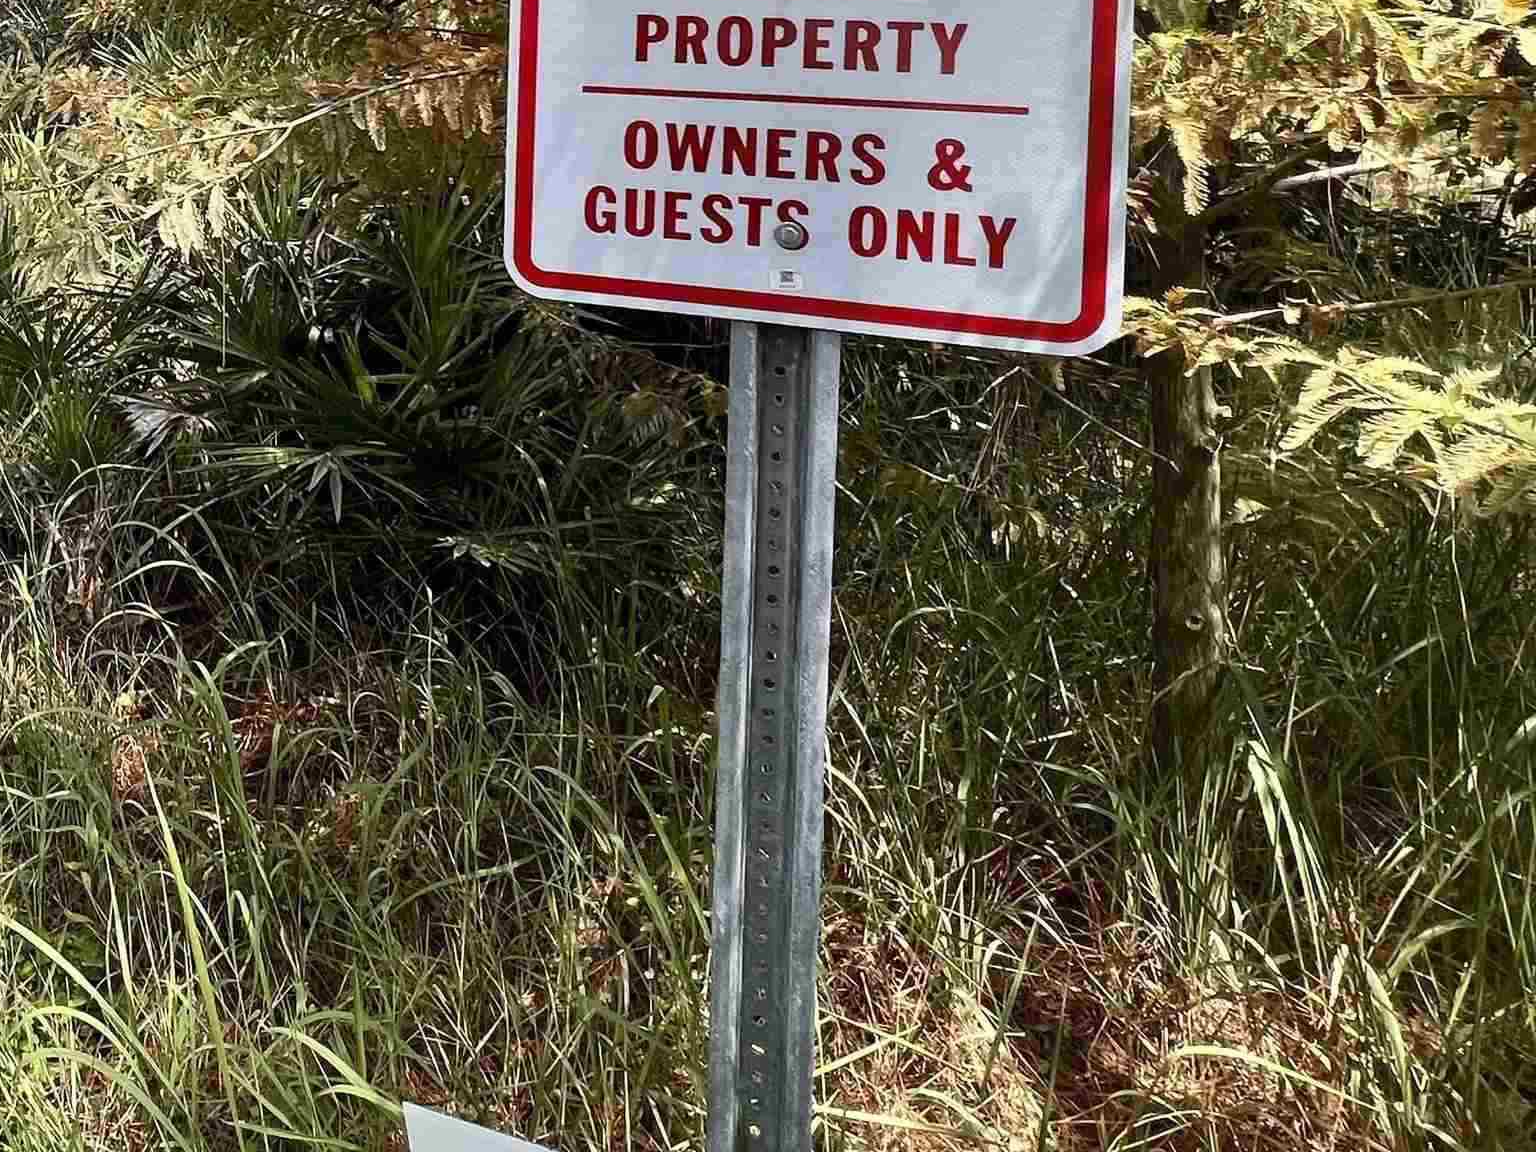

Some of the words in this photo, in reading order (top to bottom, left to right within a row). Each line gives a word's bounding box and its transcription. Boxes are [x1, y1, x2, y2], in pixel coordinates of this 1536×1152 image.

[634, 14, 969, 75] PROPERTY
[624, 120, 886, 185] OWNERS
[927, 138, 972, 192] &
[584, 185, 810, 250] GUESTS
[848, 205, 1017, 269] ONLY
